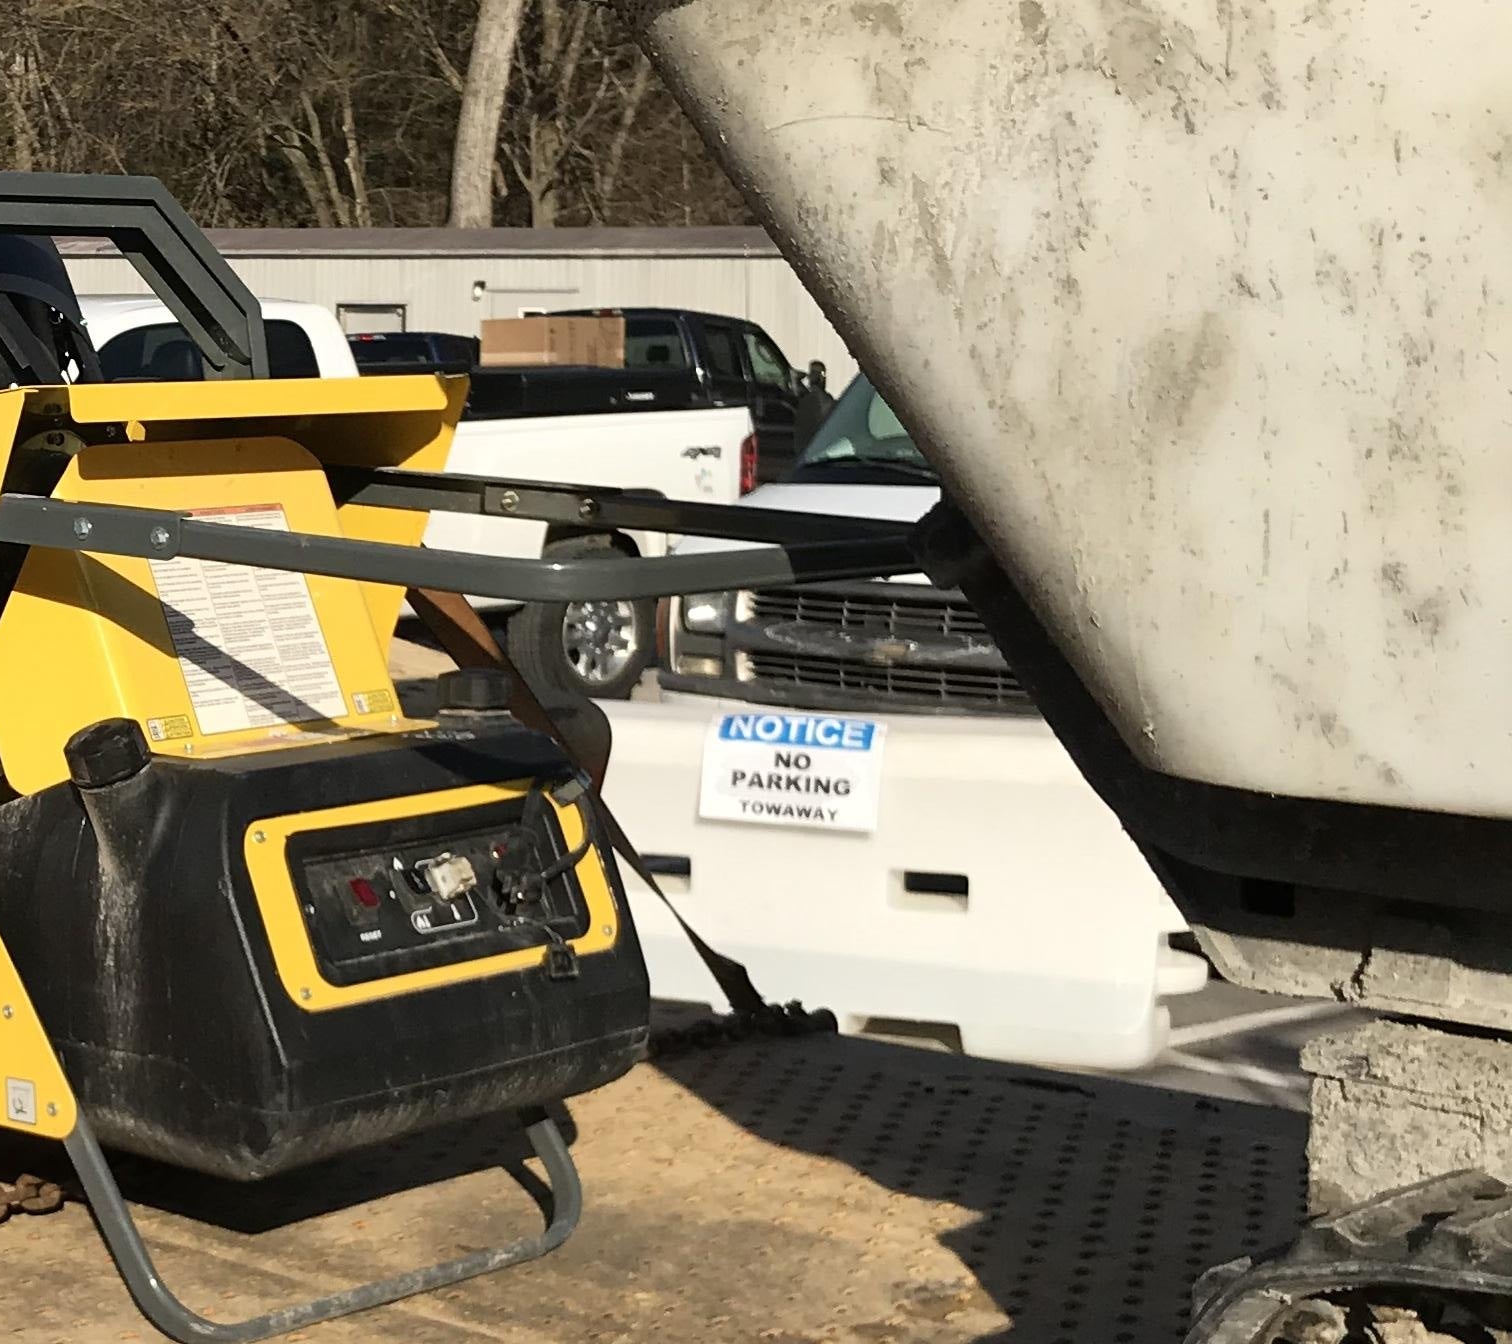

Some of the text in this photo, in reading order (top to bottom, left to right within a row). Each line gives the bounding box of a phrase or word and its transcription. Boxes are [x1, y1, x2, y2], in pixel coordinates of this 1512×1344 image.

[729, 714, 867, 748] NOTICE
[774, 751, 812, 770] NO
[731, 770, 851, 796] PARKING
[740, 799, 838, 822] TOWAWAY
